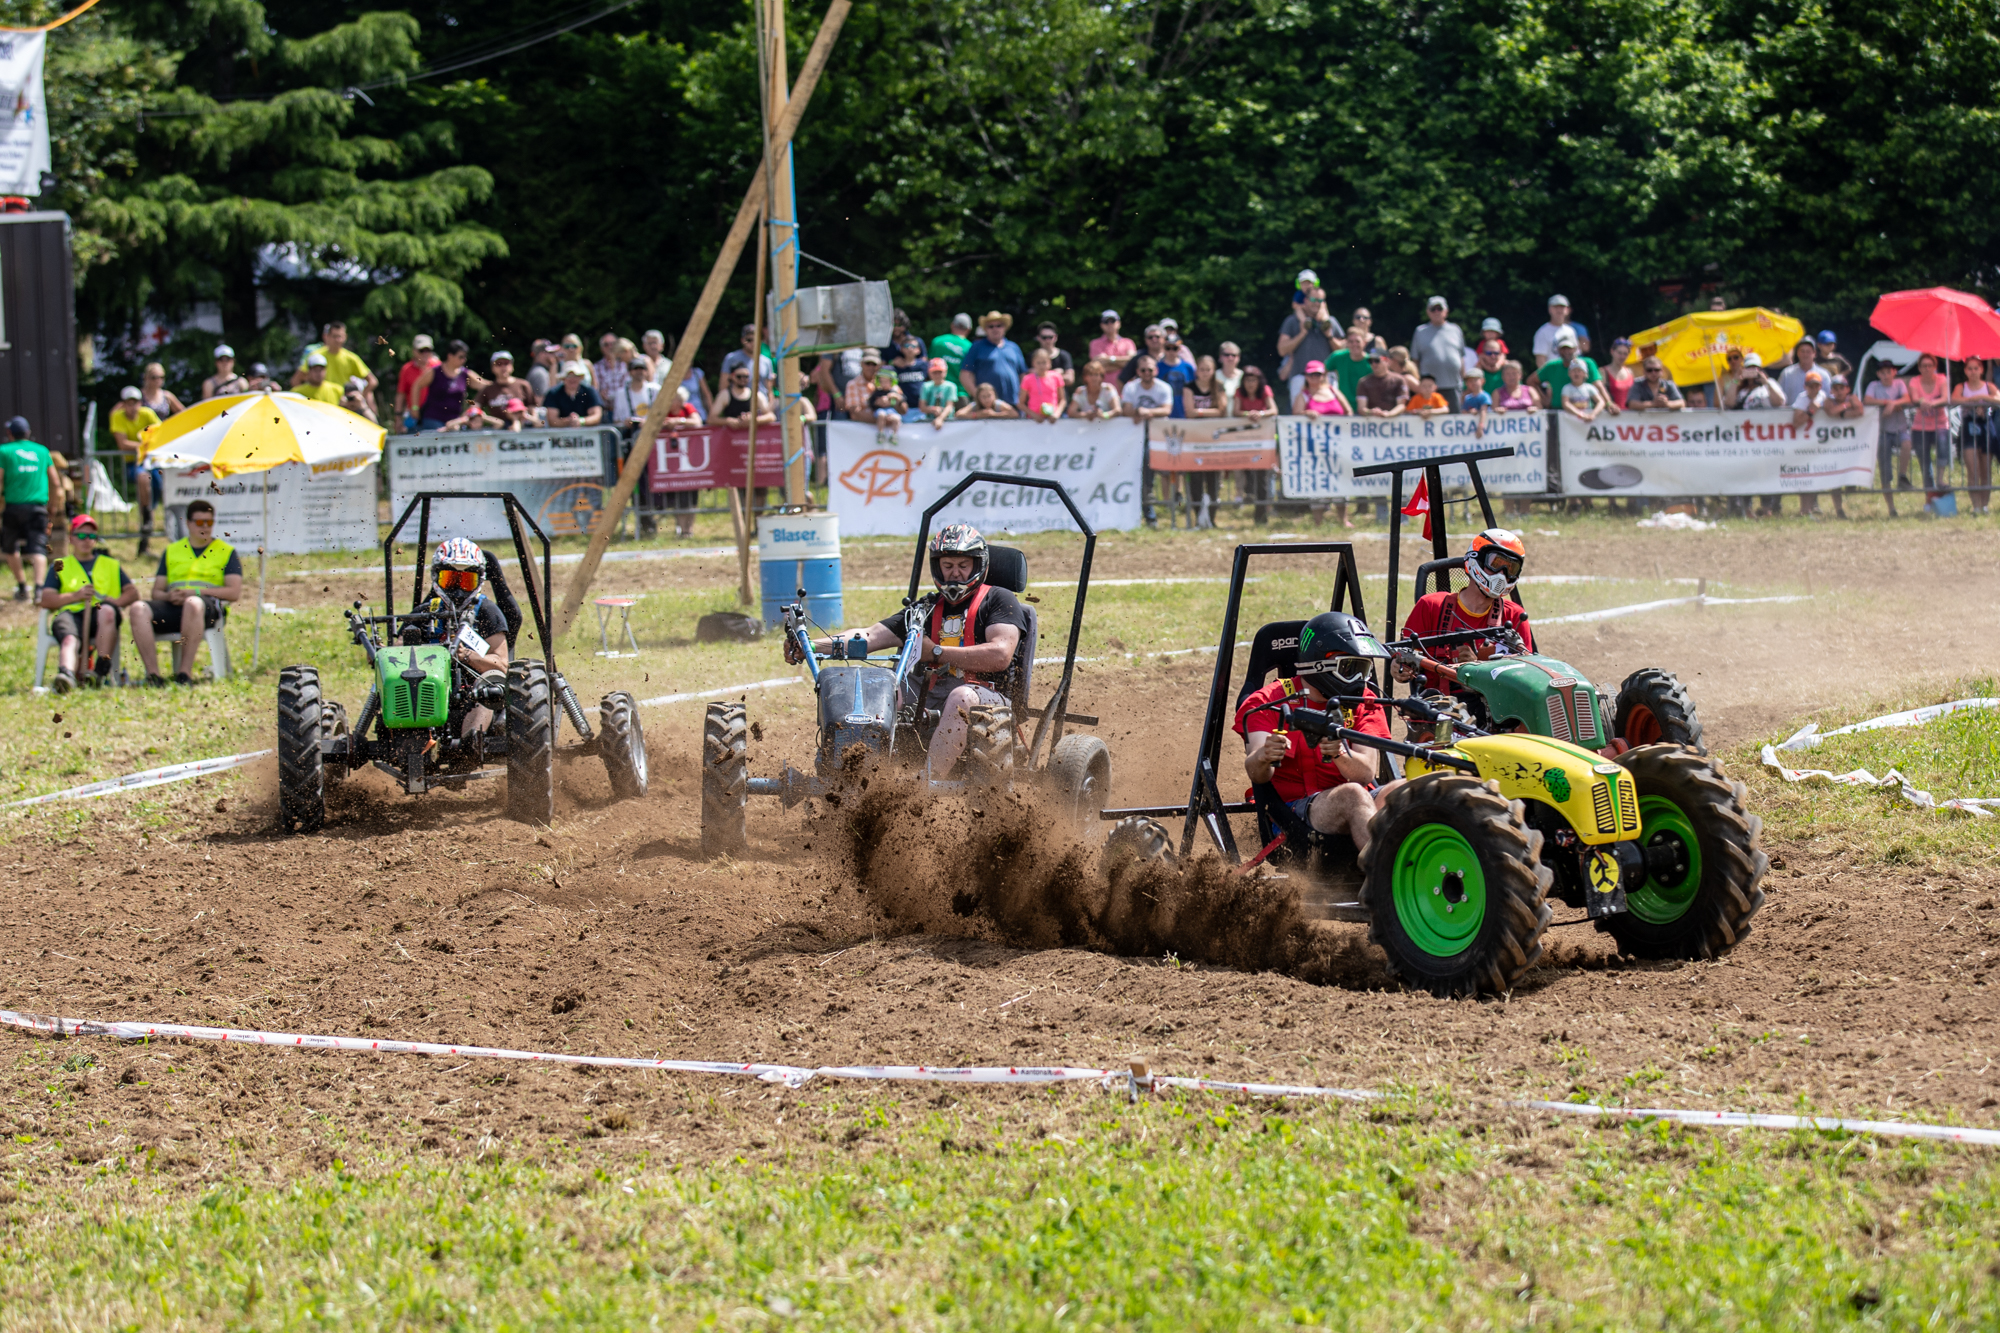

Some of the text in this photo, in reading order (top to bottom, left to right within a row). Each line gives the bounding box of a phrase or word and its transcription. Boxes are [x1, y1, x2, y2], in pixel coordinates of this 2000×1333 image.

[1441, 416, 1541, 437] GRAVUREN
[397, 436, 594, 457] expert Cäsar Kälin
[1351, 446, 1363, 461] &
[1515, 441, 1541, 458] AG
[1649, 448, 1665, 458] und
[937, 447, 1097, 475] Metzgerei
[1779, 463, 1809, 474] Kanal
[1088, 481, 1133, 504] AG
[1779, 478, 1813, 488] Widmer
